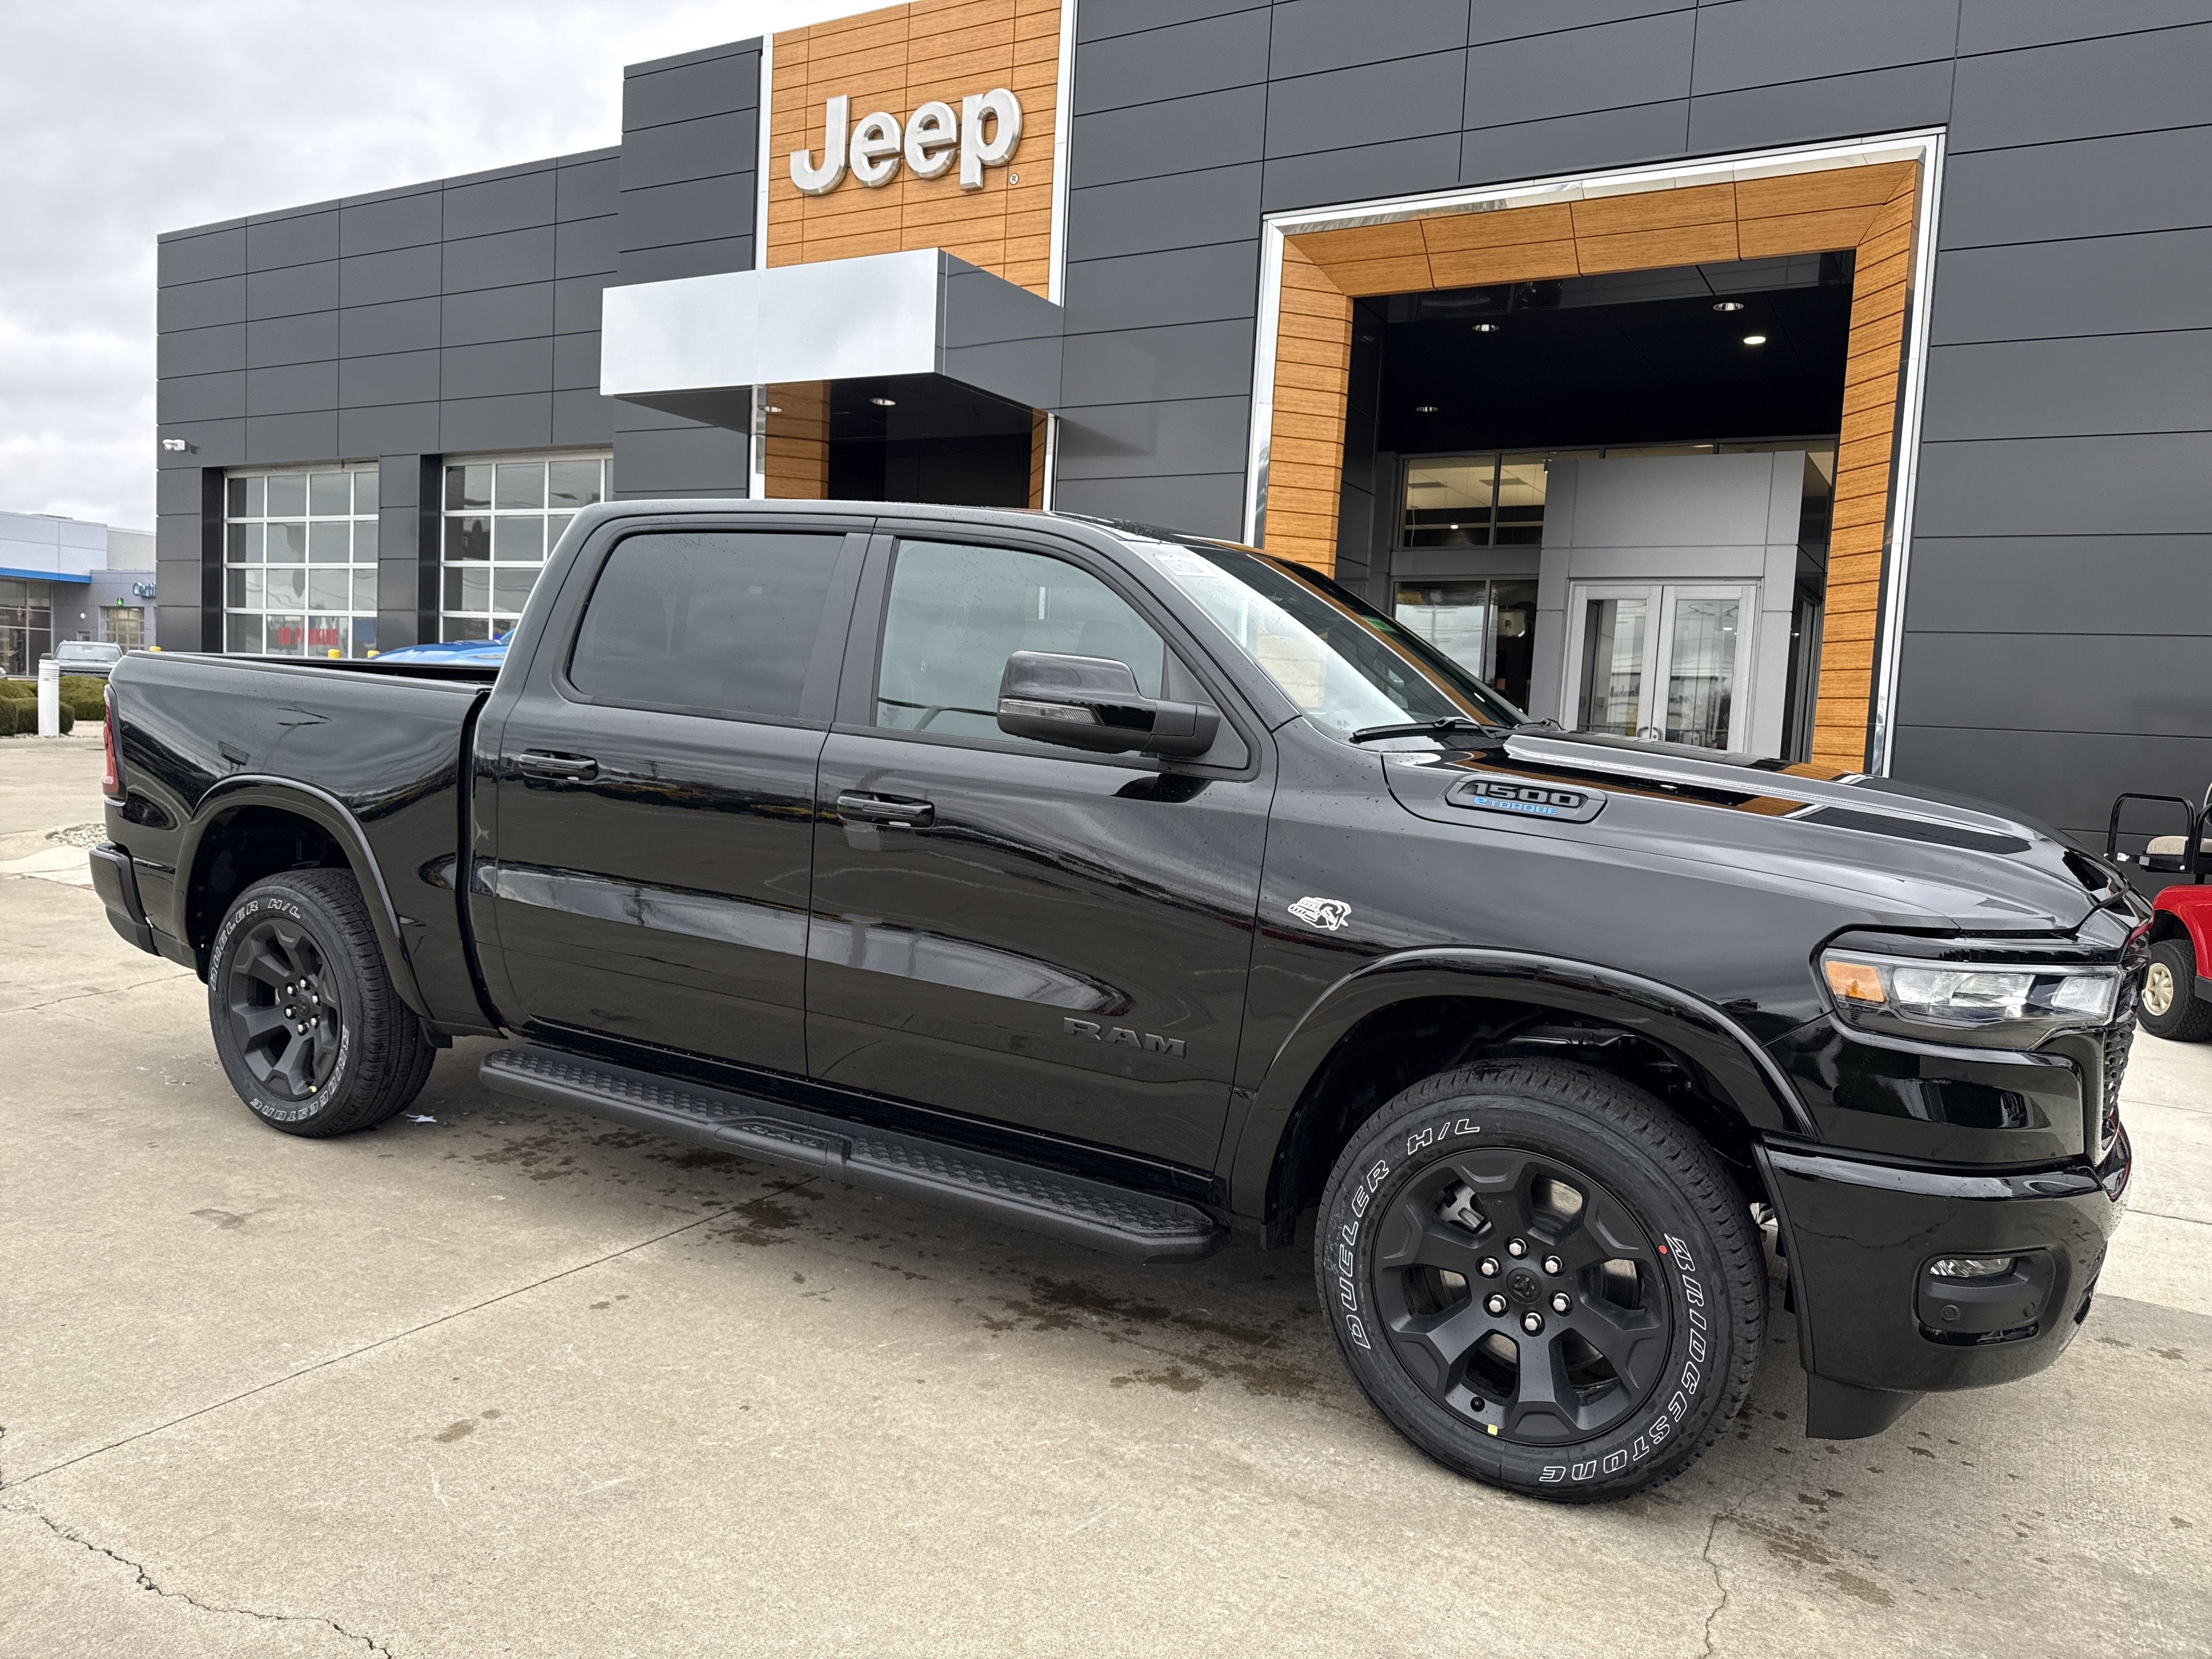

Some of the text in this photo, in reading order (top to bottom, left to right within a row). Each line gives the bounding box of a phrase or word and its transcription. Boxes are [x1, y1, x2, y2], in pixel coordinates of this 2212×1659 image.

[790, 88, 1022, 195] Jeep
[278, 627, 291, 645] NO
[1473, 782, 1580, 807] 1500
[211, 898, 302, 991] DUELER H/L
[250, 1024, 350, 1122] BRIDGESTONE
[1063, 1017, 1186, 1060] RAM
[1336, 1118, 1481, 1350] DUELER H/L
[1539, 1233, 1707, 1483] BRIDGESTONE
